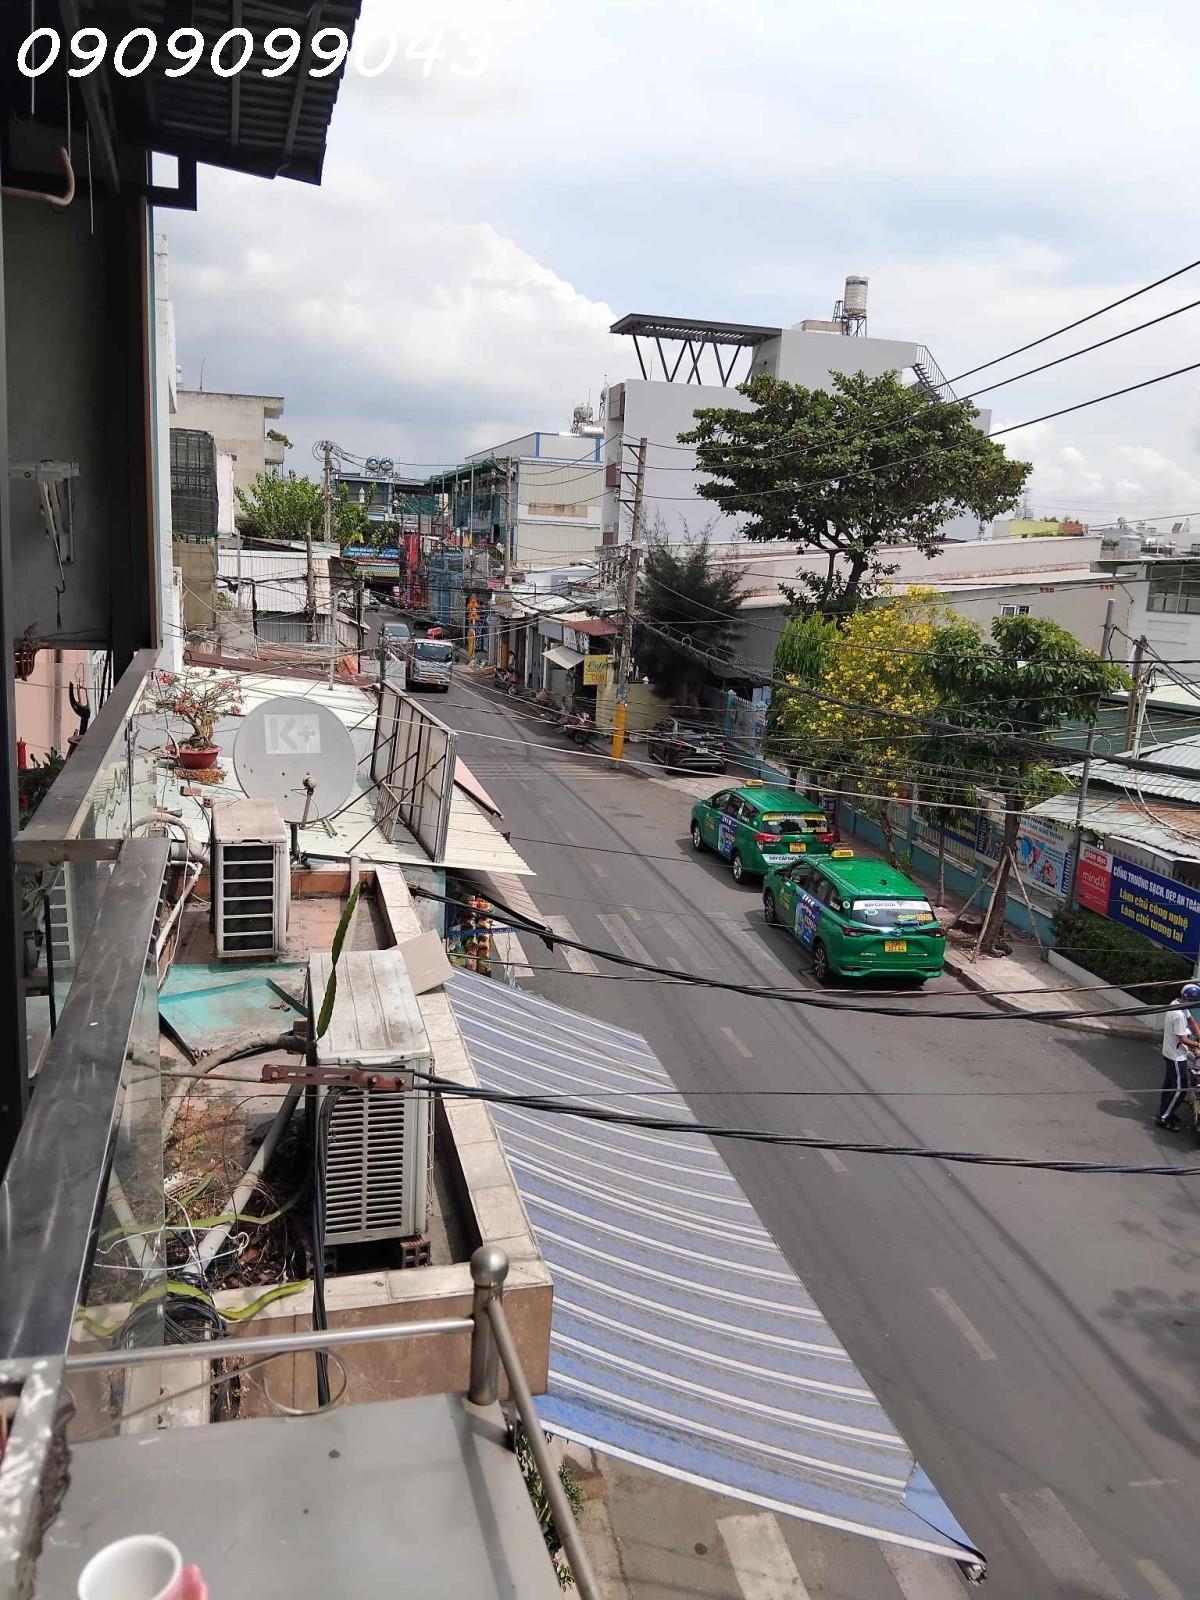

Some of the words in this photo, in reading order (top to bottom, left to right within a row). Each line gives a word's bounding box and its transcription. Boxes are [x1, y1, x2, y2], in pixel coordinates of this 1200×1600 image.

[267, 716, 317, 751] K+
[1119, 888, 1135, 904] Làm
[1134, 895, 1149, 911] chủ
[1120, 904, 1136, 920] Làm
[1135, 912, 1150, 927] chủ
[1172, 928, 1184, 943] lai
